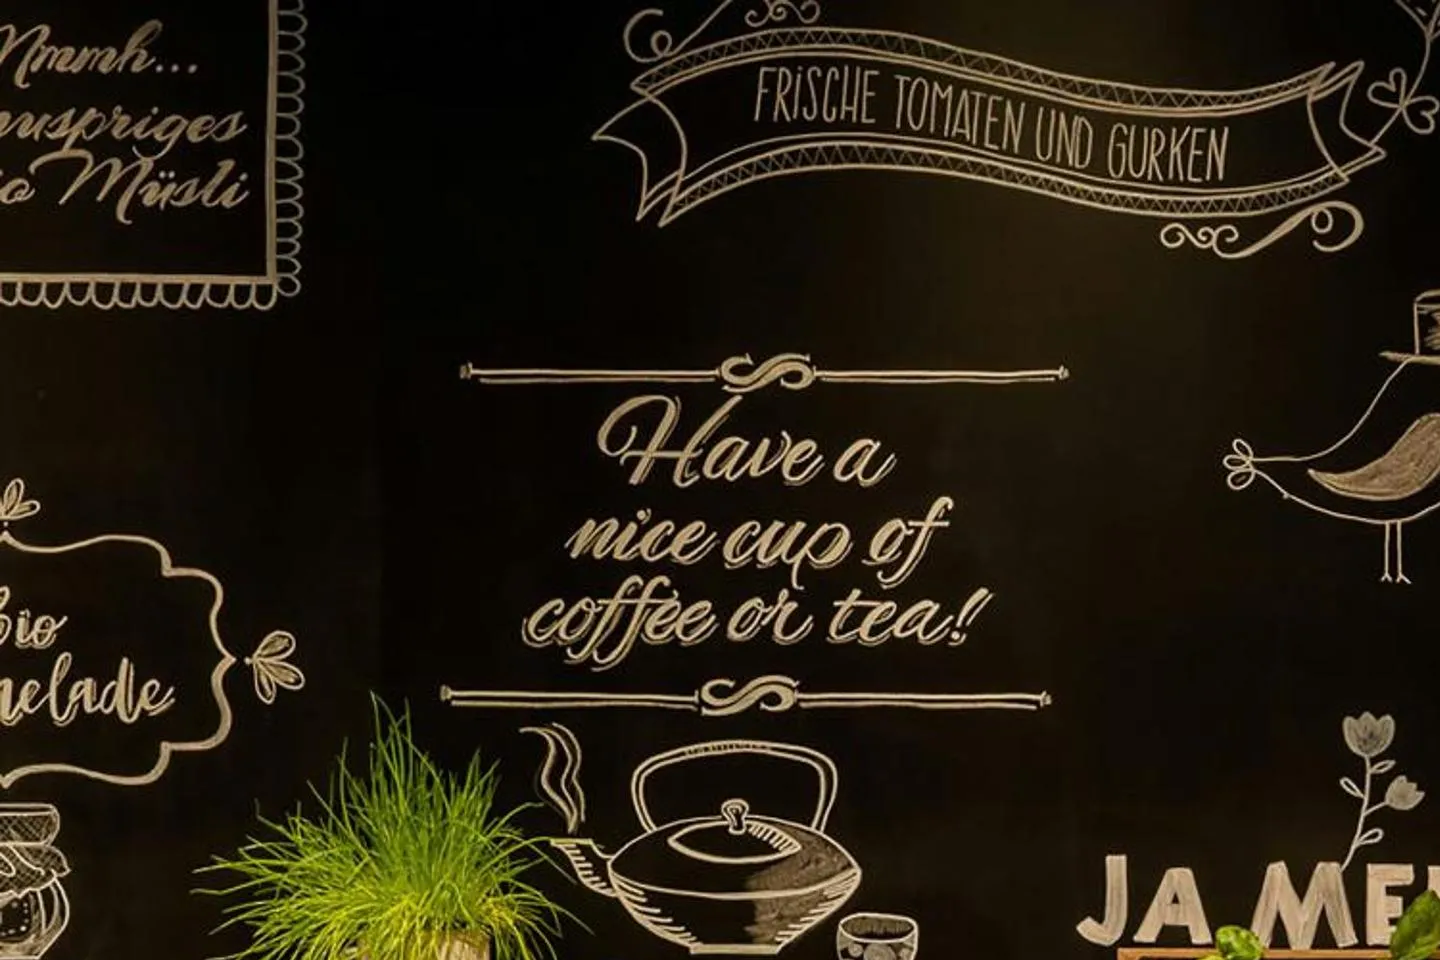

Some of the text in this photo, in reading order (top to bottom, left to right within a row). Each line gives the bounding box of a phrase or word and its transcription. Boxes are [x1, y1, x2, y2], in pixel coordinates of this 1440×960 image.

[894, 74, 1026, 152] TOMATEN
[1034, 108, 1093, 169] UND
[1108, 123, 1229, 182] GURKEN
[29, 149, 250, 225] Müsli
[596, 394, 897, 488] Have a
[564, 496, 954, 589] nice cup of
[521, 574, 996, 672] coffee or tea!
[1076, 854, 1213, 946] JA
